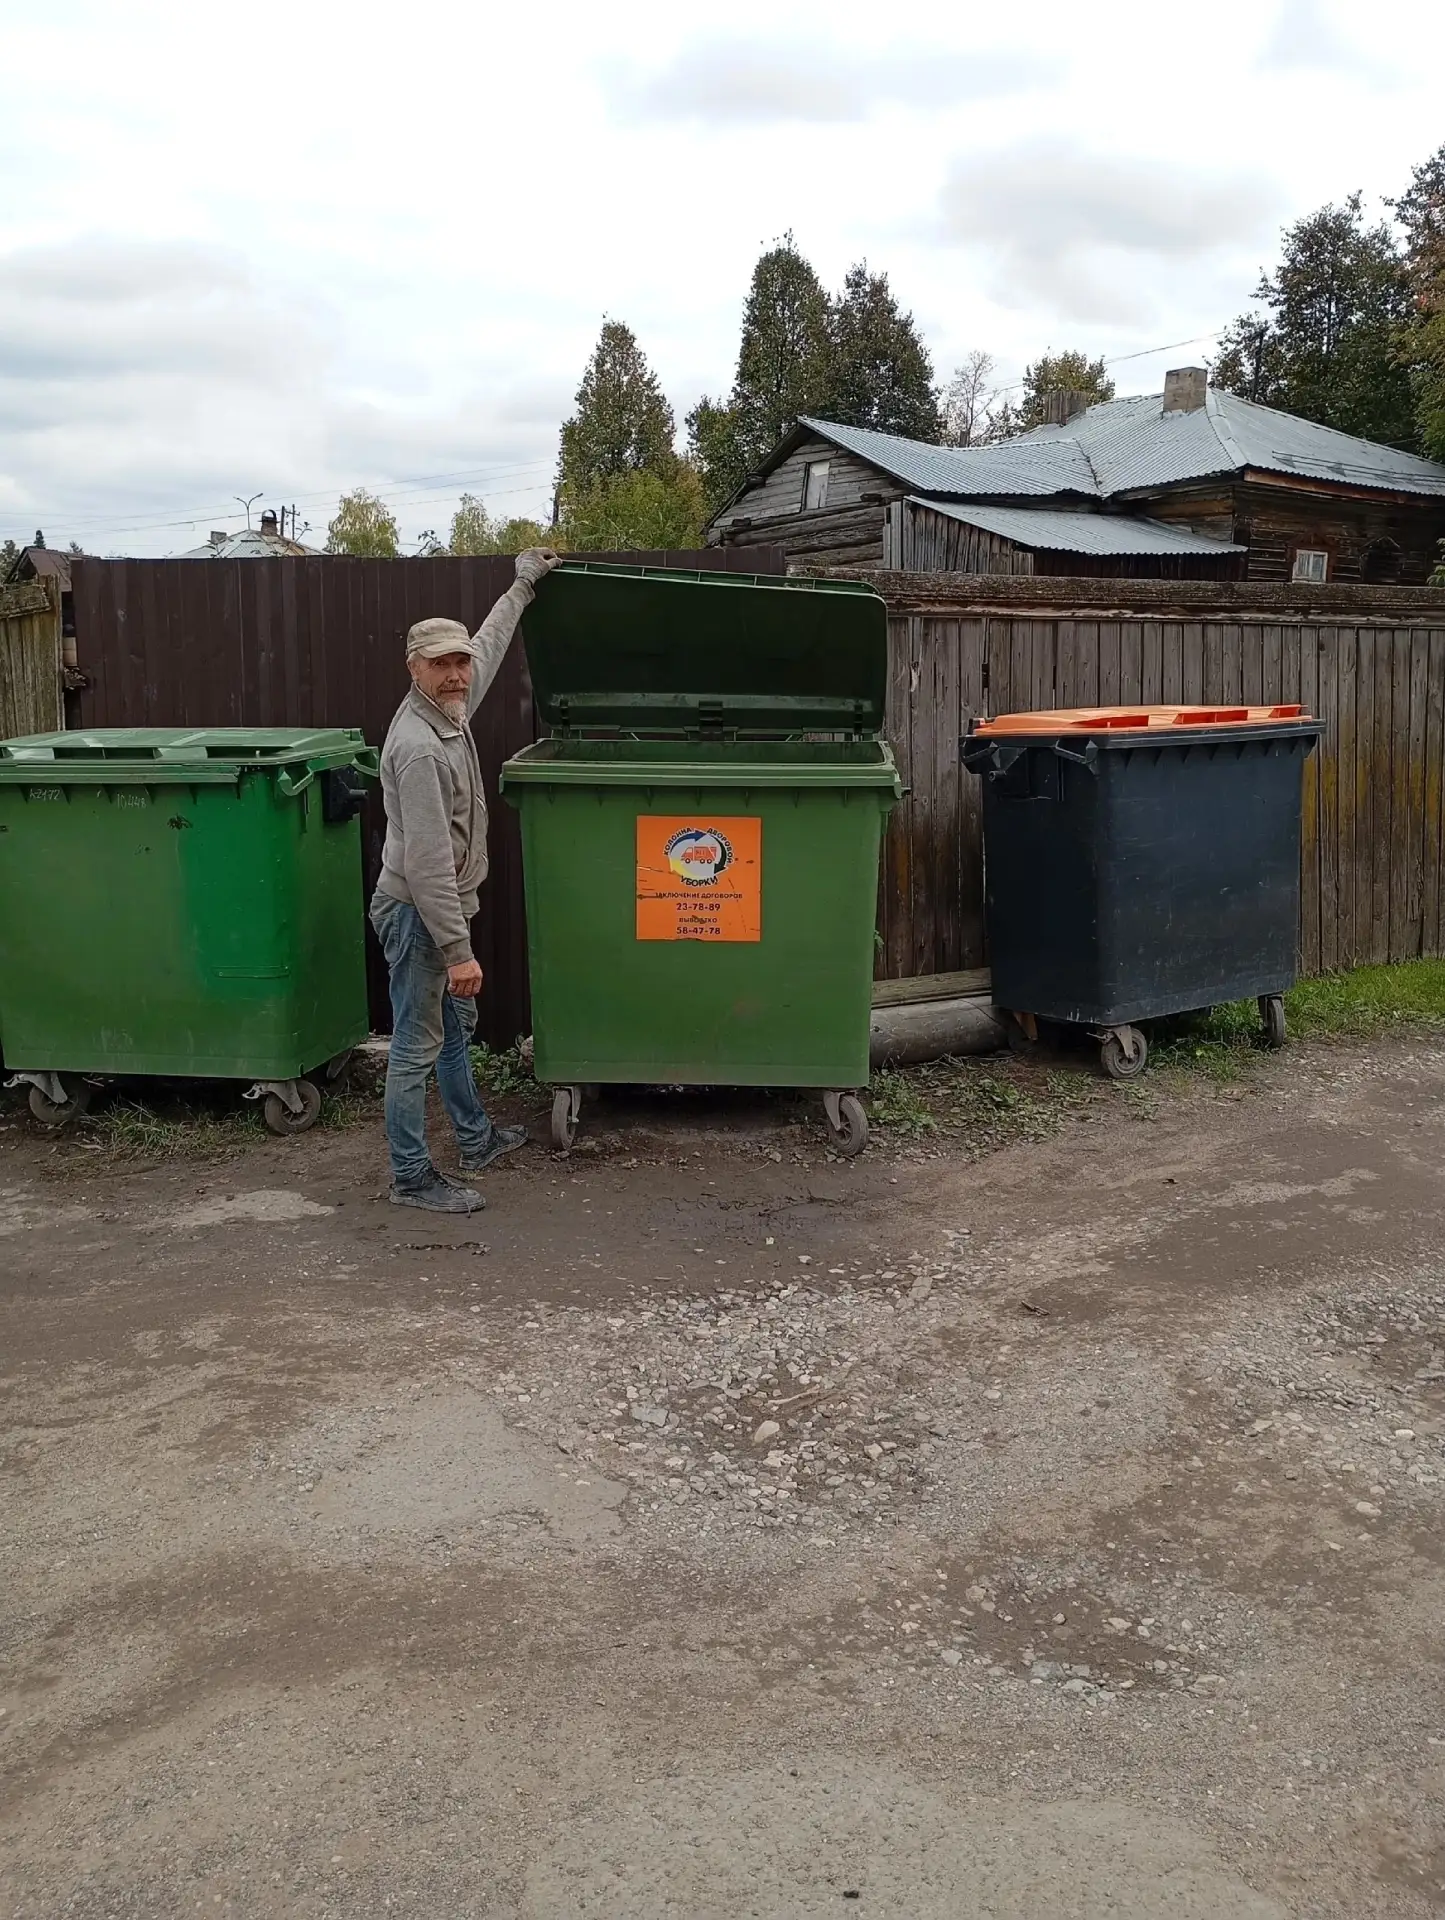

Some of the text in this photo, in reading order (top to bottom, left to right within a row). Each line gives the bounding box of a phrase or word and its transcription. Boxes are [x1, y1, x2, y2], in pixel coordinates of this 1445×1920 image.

[664, 827, 692, 856] КОЛОННА
[707, 828, 734, 864] ДВОРОВОЙ
[680, 875, 718, 887] УБОРКИ
[676, 903, 721, 911] 23-78-89
[676, 927, 721, 935] 58-47-78
